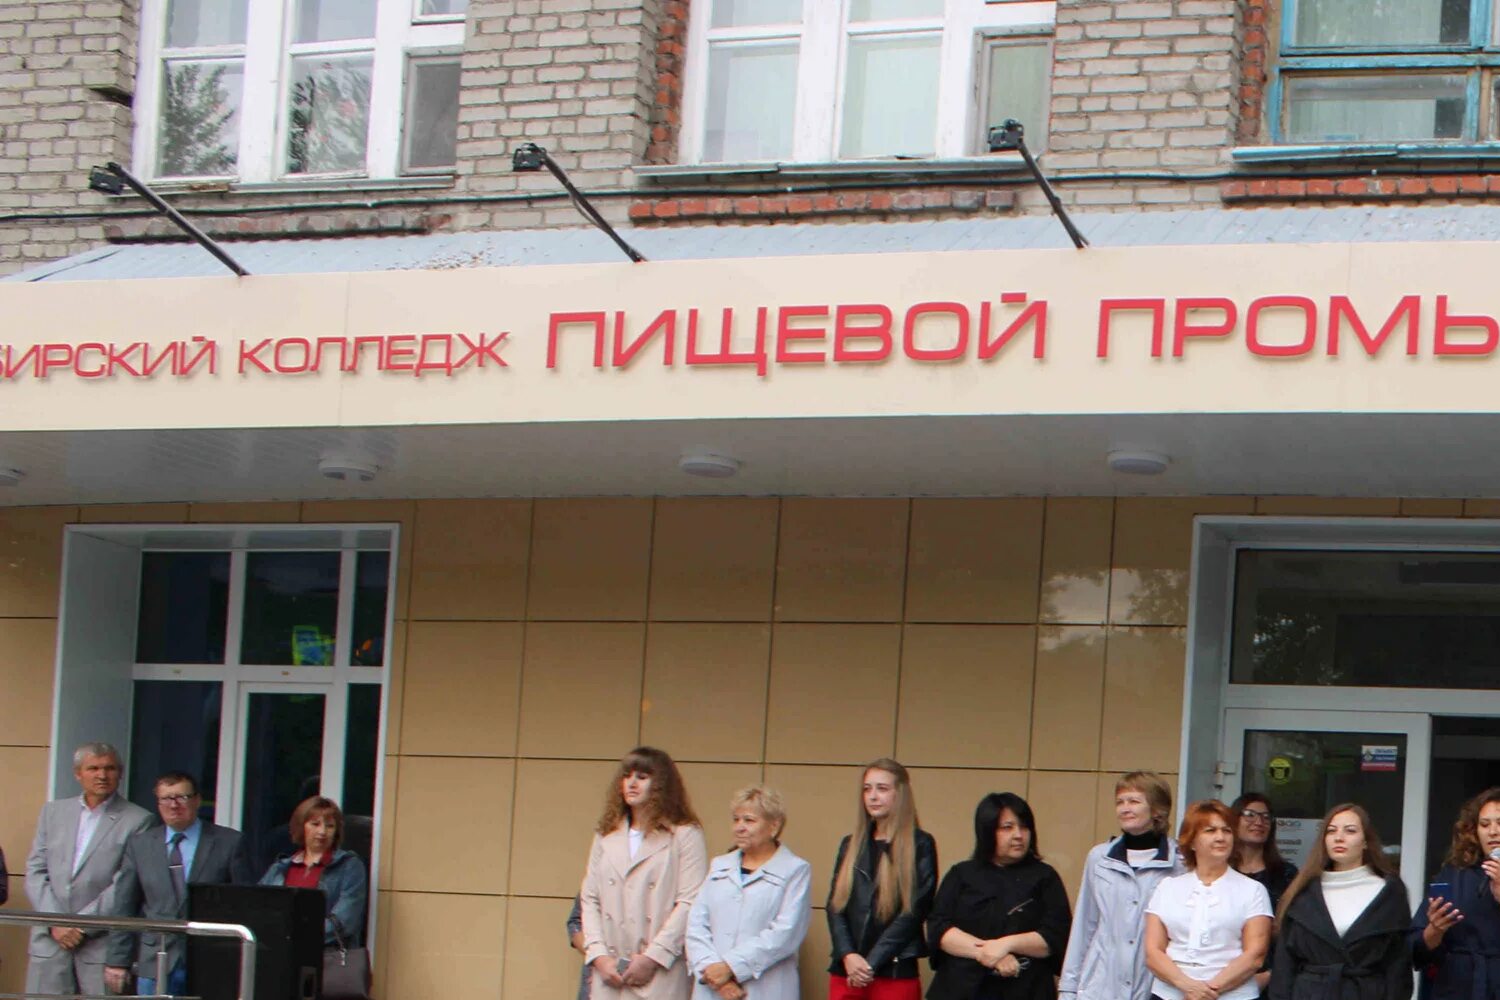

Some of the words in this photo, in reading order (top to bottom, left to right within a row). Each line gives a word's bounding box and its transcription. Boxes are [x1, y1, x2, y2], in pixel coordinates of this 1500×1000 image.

[0, 336, 216, 378] ИРСКИЙ
[239, 332, 509, 378] КОЛЛЕДЖ
[546, 293, 1049, 377] ПИЩЕВОЙ
